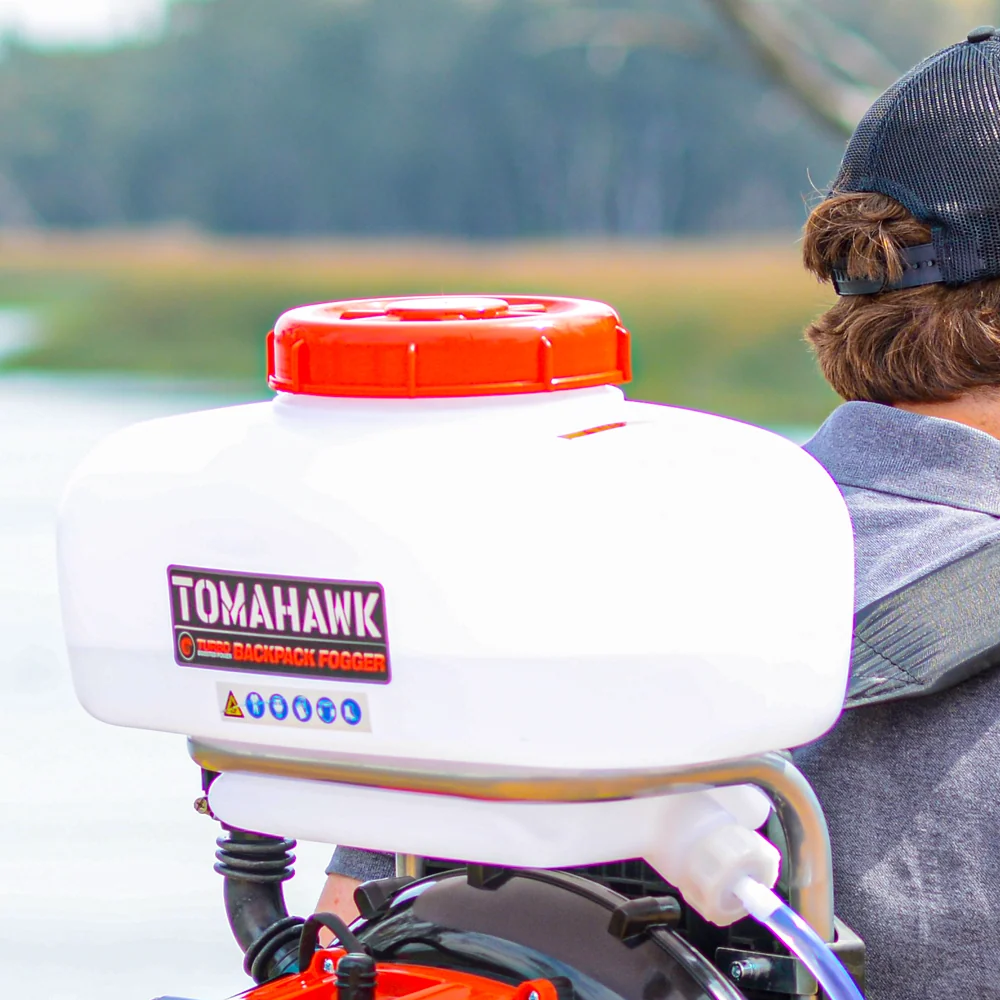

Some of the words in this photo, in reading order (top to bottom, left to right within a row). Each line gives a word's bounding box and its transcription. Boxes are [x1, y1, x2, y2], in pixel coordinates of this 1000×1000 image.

[171, 575, 382, 638] TOMAHAWK
[233, 642, 316, 667] BACKPACK
[318, 649, 386, 673] FOGGER
